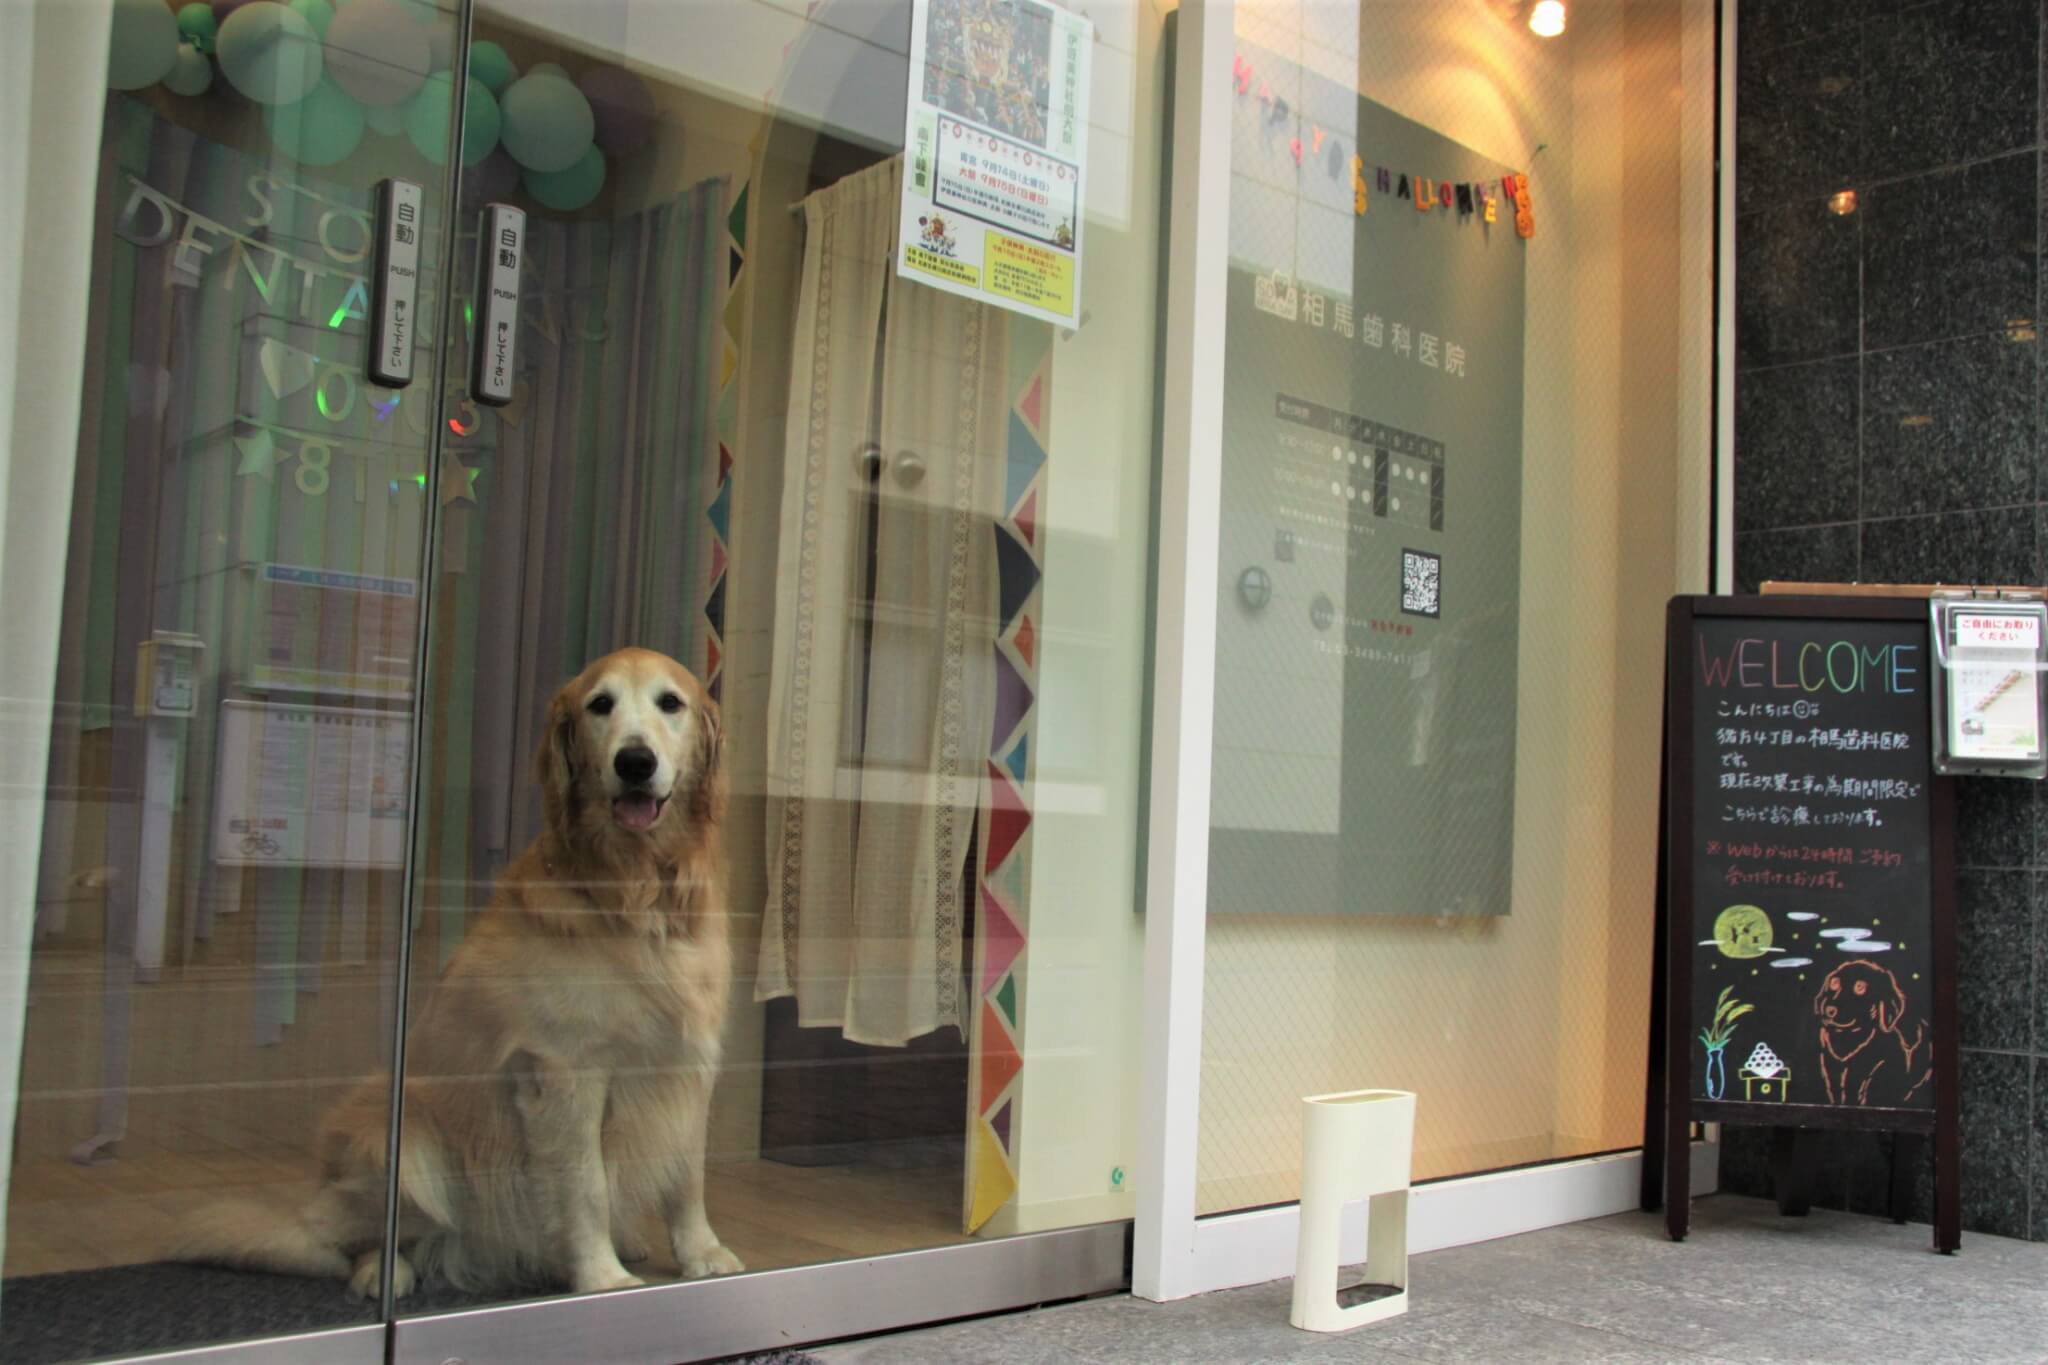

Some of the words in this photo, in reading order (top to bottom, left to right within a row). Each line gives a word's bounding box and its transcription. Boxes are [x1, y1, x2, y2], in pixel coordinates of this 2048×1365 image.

[393, 202, 416, 246] 自動
[498, 227, 518, 269] 自動
[390, 264, 416, 279] PUSH
[493, 288, 517, 301] PUSH
[390, 299, 405, 368] 押して下さい
[493, 321, 508, 387] 押して下さい
[1302, 289, 1466, 377] 相馬歯科医院
[1961, 618, 2034, 631] ご自由にお取り
[1977, 631, 2019, 641] ください
[1699, 636, 1919, 693] WELCOME
[1720, 753, 1749, 769] です。
